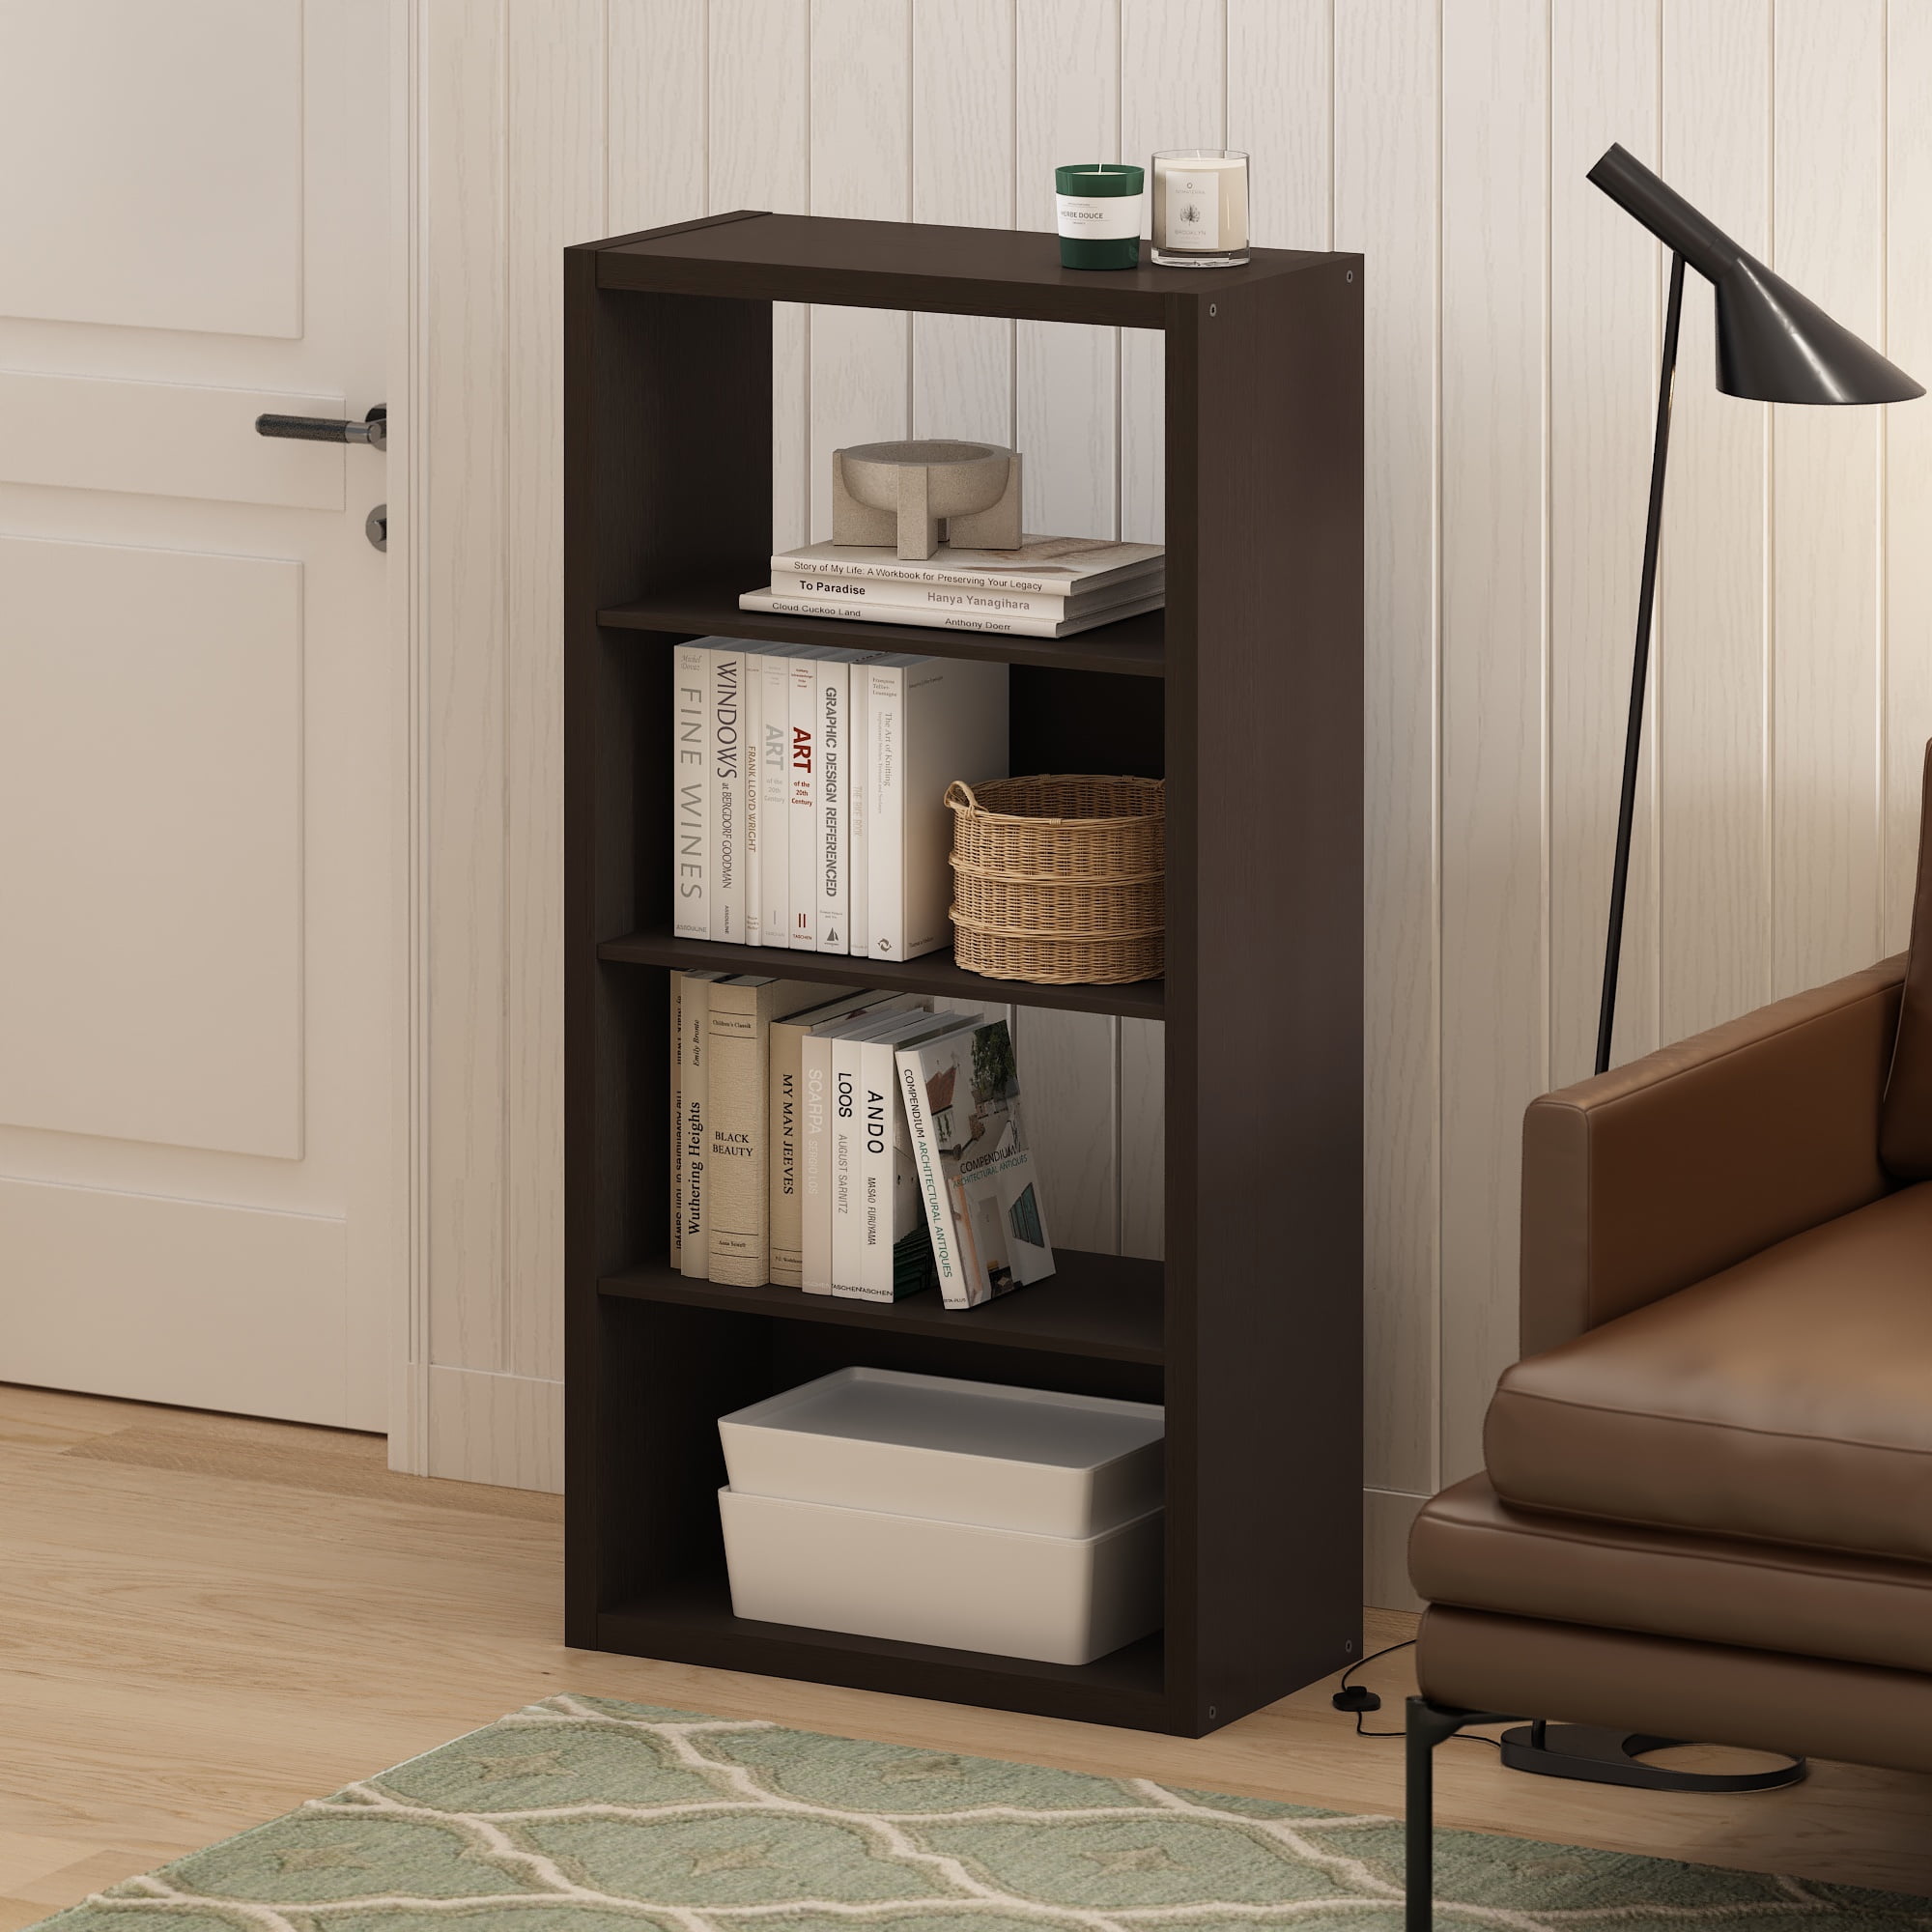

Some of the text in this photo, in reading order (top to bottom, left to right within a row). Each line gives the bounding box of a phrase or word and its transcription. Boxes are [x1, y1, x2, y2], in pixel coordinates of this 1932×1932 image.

[794, 561, 817, 572] Story
[820, 563, 828, 572] of
[831, 564, 843, 575] My
[846, 566, 865, 576] Life:
[876, 568, 921, 580] Workbook
[937, 574, 985, 586] Preserving
[987, 578, 1009, 587] Your
[1010, 579, 1042, 591] Legacy
[799, 580, 1030, 611] To Paradise Hanya Yanagihara
[773, 602, 1011, 631] Cloud Cuckoo Land Anthony Doerr
[717, 661, 737, 779] WINDOWS
[826, 687, 837, 749] GRAPHIC
[766, 724, 784, 771] ART
[792, 726, 811, 773] ART
[883, 754, 893, 786] Knitting
[885, 744, 893, 753] of
[680, 688, 702, 899] FINE WINES
[748, 746, 756, 853] FRANK LLOYD WRIGHT
[826, 753, 837, 803] DESIGN
[723, 792, 732, 838] BERGDORF
[792, 798, 813, 808] Century
[723, 840, 732, 889] GOODMAN
[826, 807, 837, 897] REFERENCED
[693, 1045, 701, 1066] Emily
[809, 1068, 823, 1134] SCARPA
[713, 1144, 753, 1157] BEAUTY
[715, 1131, 750, 1144] BLACK
[782, 1074, 794, 1195] MY MAN JEEVES
[838, 1072, 852, 1214] LOOS AUGUST SARNITZ
[688, 1101, 703, 1235] Wuthering Heights
[867, 1090, 885, 1246] ANDO MASAO FURUYAMA
[904, 1068, 952, 1278] COMPENDIUM ARCHITECTURAL ANTIQUES
[952, 1153, 1028, 1189] ARCHITECTURAL ANTIQUES
[960, 1144, 1016, 1174] COMPENDIUM
[831, 1283, 862, 1293] TASCHEN
[860, 1287, 893, 1296] TASCHEN
